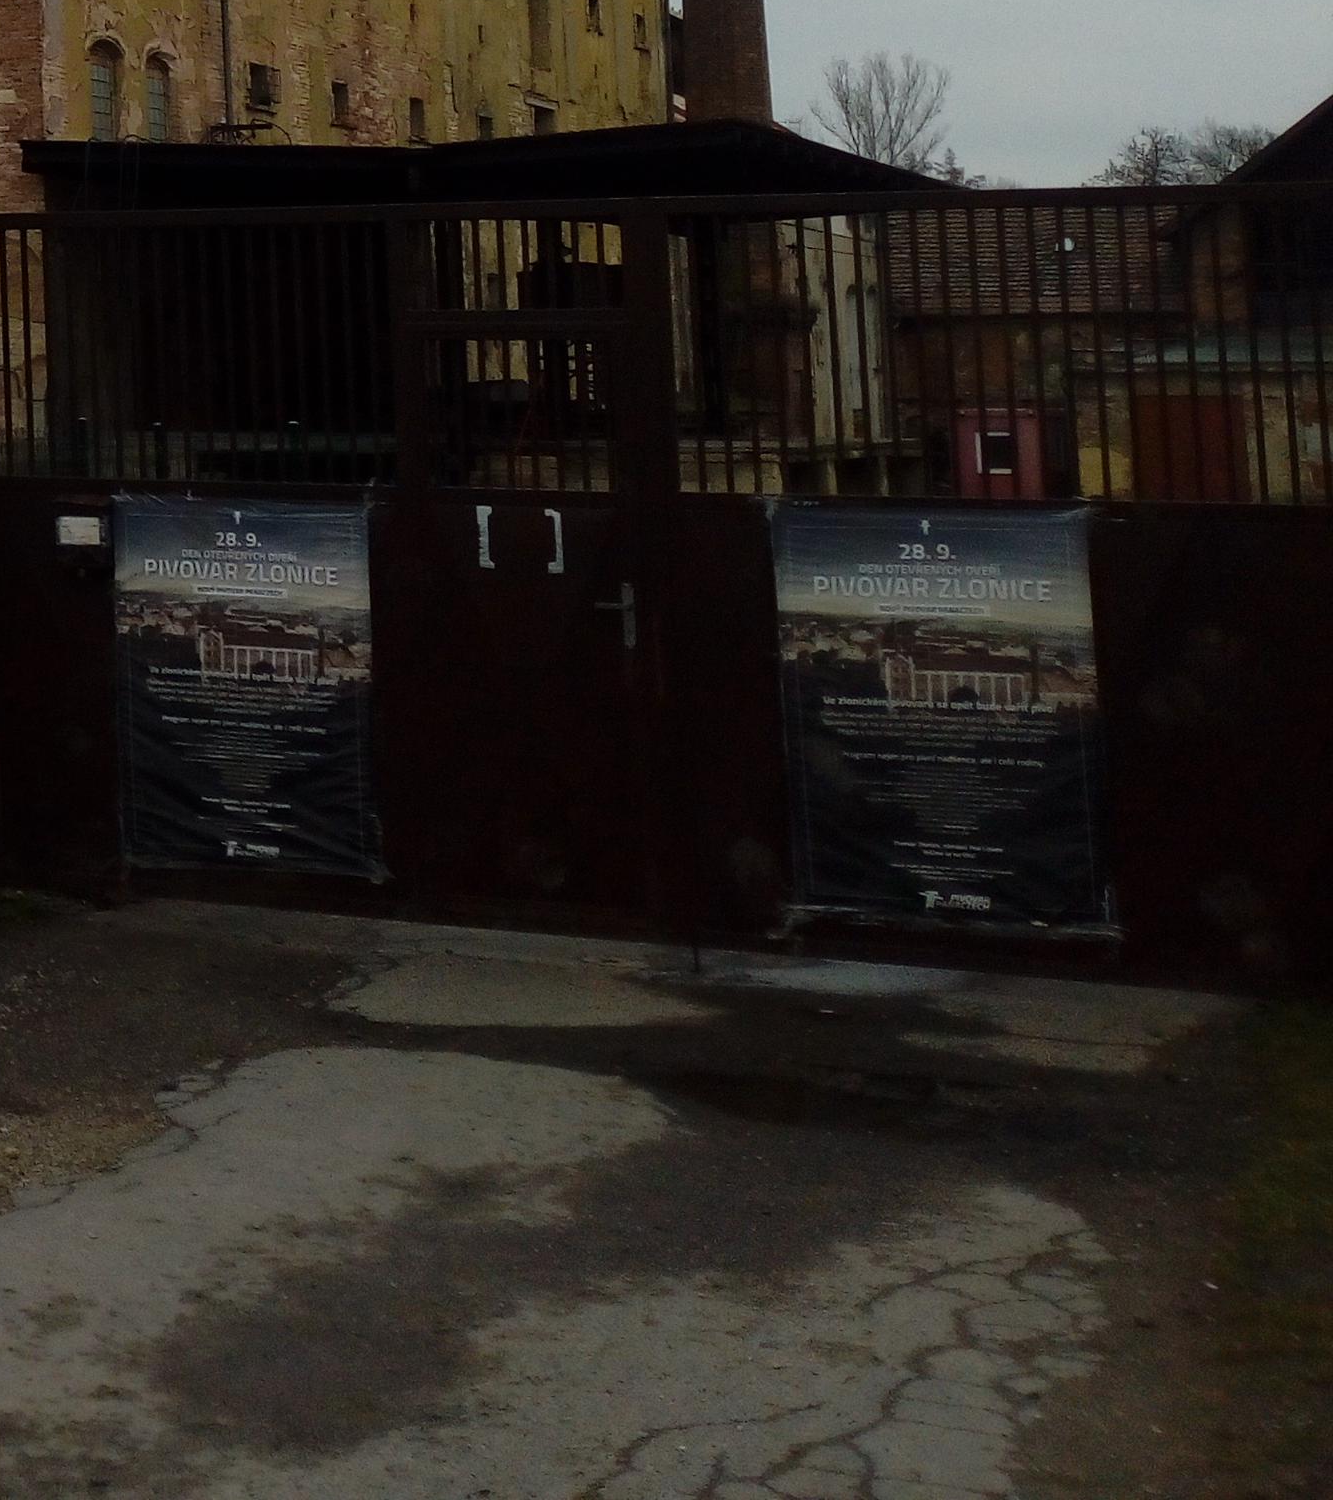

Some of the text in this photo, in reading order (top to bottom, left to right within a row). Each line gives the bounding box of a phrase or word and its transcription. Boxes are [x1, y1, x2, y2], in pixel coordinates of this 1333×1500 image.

[215, 532, 262, 548] 28. 9.
[898, 543, 956, 561] 28. 9.
[144, 558, 340, 587] PIVOVAR ZLONICE
[858, 564, 883, 574] DEN
[813, 576, 1053, 602] PIVOVAR ZLONICE
